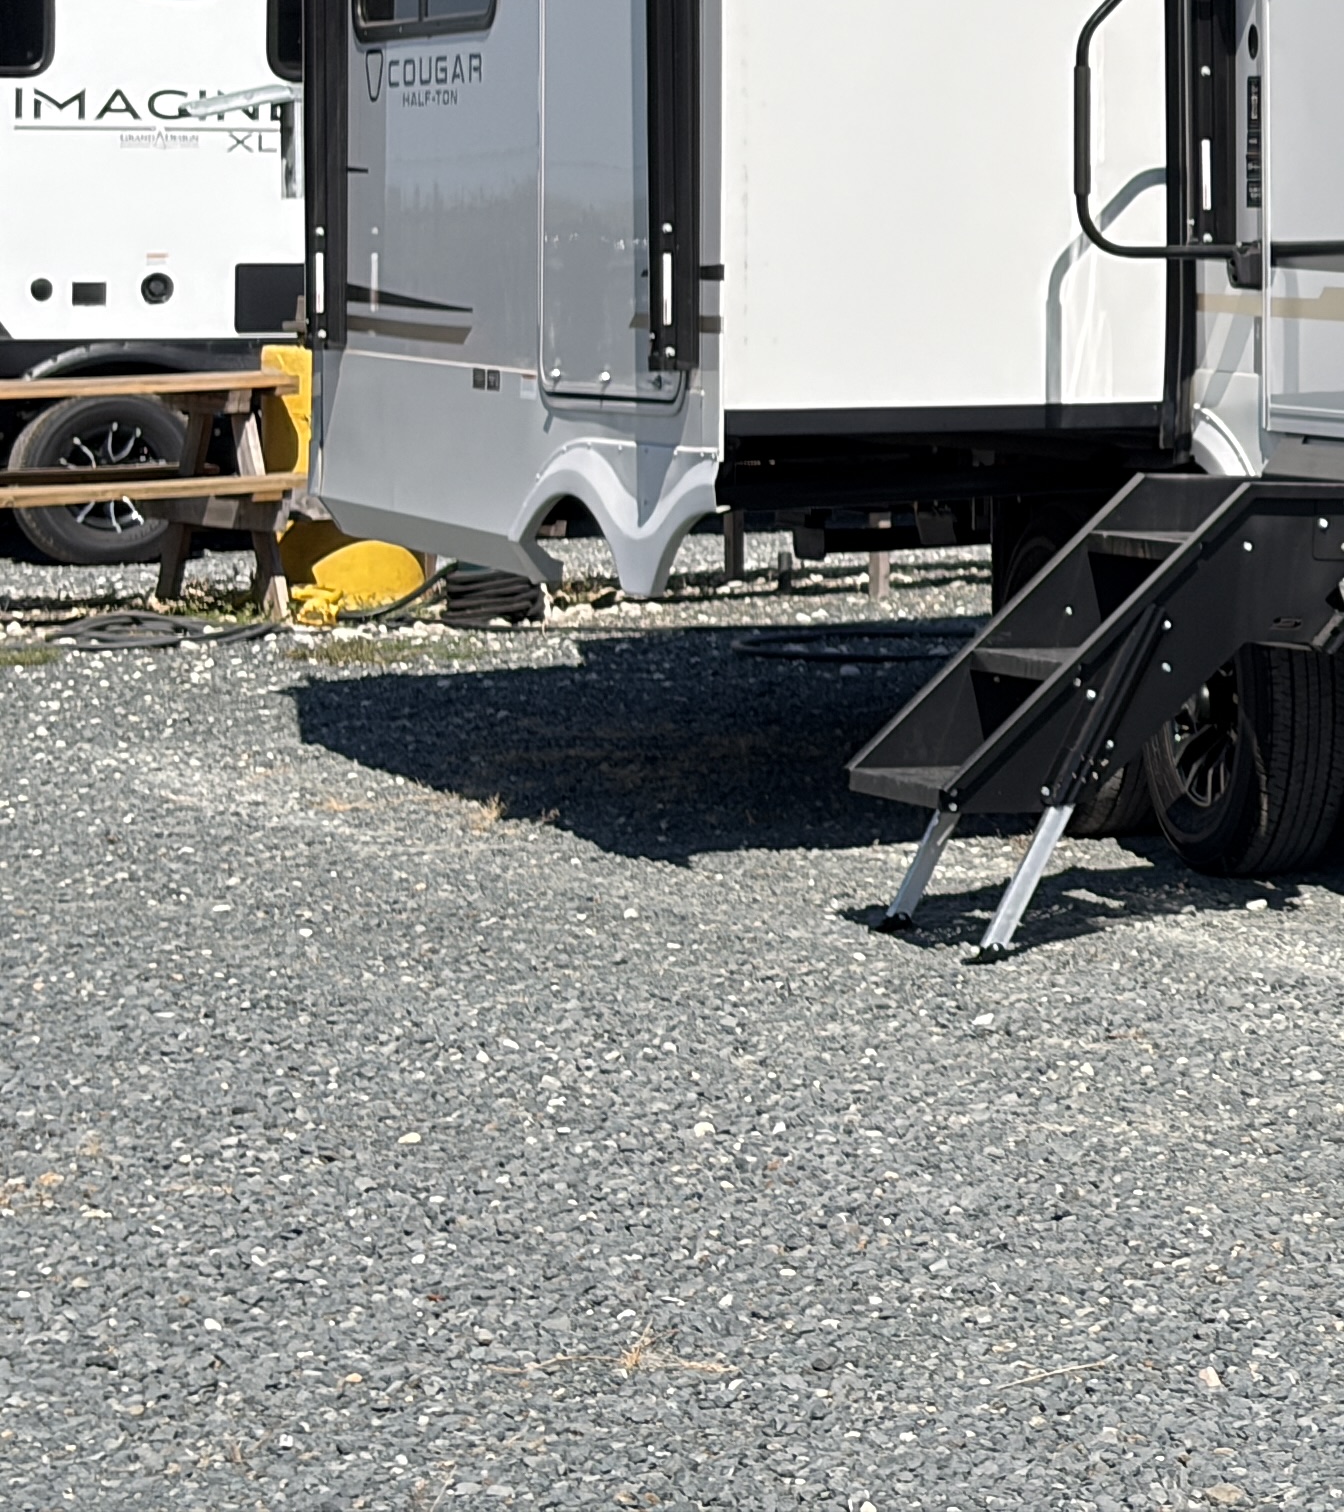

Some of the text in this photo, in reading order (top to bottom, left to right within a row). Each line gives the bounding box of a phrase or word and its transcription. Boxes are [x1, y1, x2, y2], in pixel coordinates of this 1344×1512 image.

[388, 53, 482, 88] COUGAR
[14, 87, 281, 121] IMAG
[402, 89, 458, 107] HALF-TON
[227, 131, 277, 153] XL
